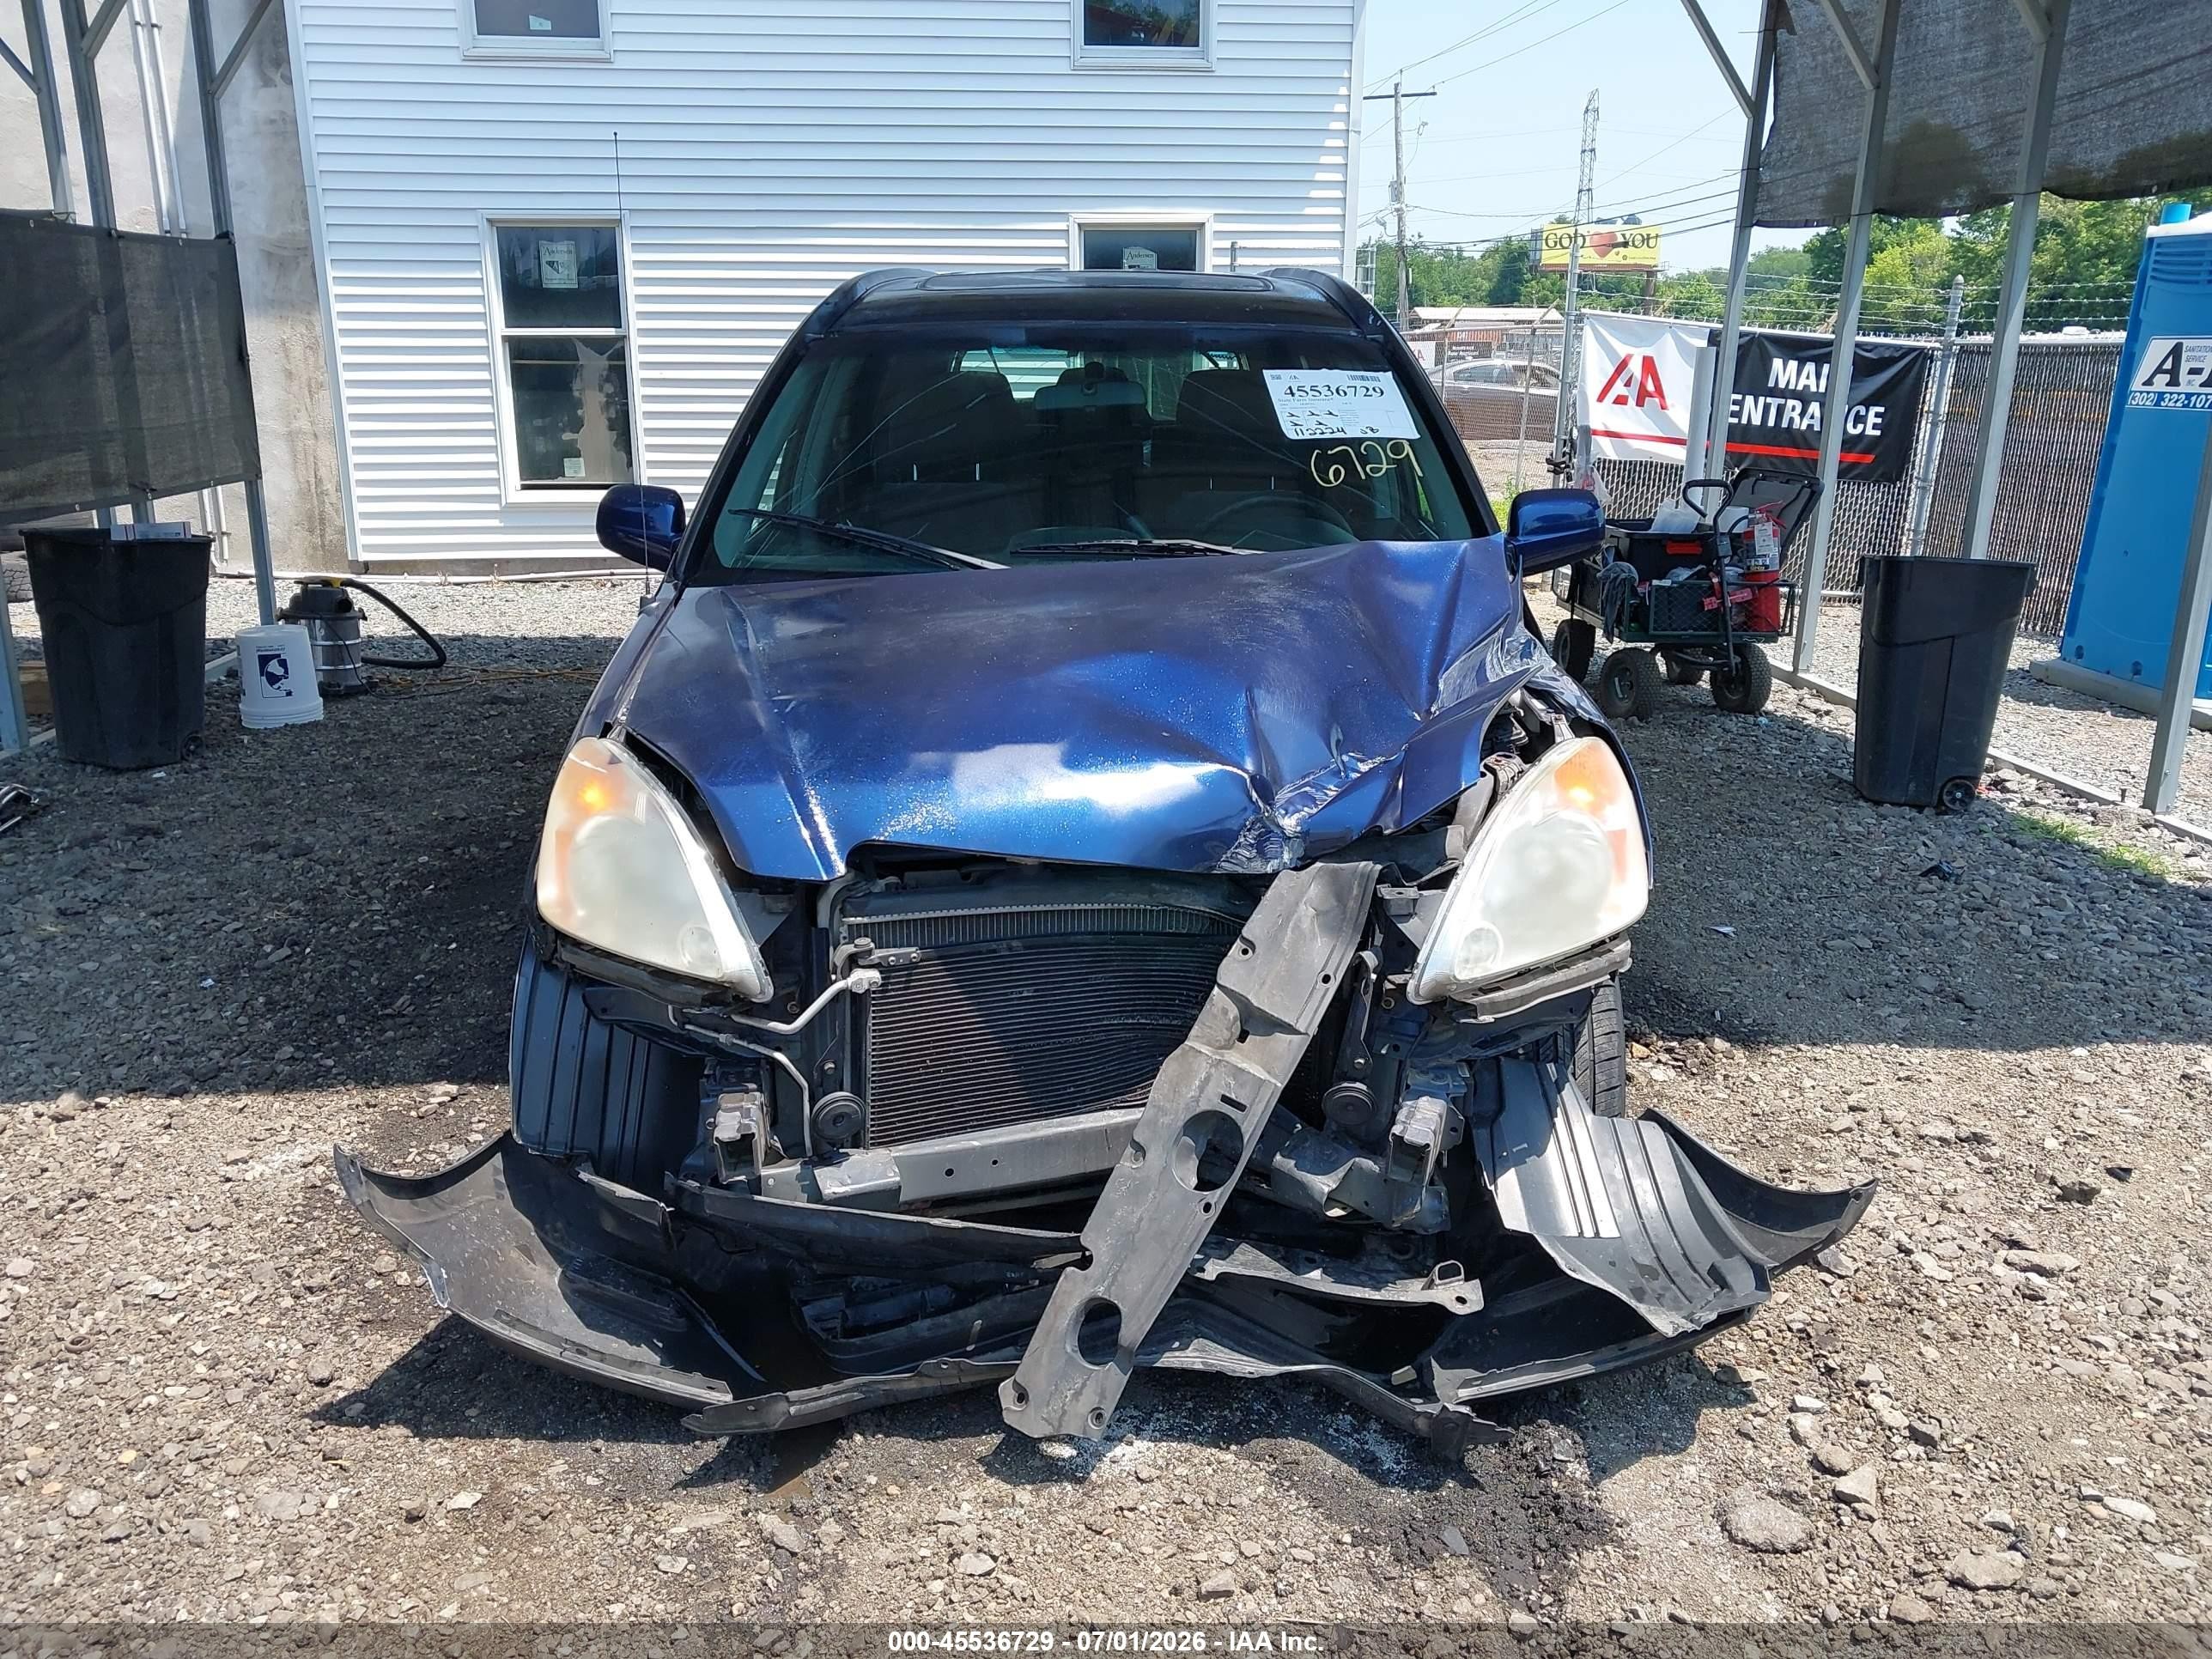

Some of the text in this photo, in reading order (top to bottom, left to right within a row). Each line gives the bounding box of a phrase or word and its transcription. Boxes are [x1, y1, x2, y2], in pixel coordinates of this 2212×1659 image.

[1620, 233, 1659, 249] YOU
[1127, 250, 1154, 260] Andersen
[2185, 355, 2208, 363] SERVICE
[1767, 357, 1854, 393] MAI
[1284, 385, 1384, 398] 45536729
[2128, 392, 2158, 405] (302)
[1728, 393, 1885, 436] ENTRACE
[1310, 440, 1424, 487] 6729
